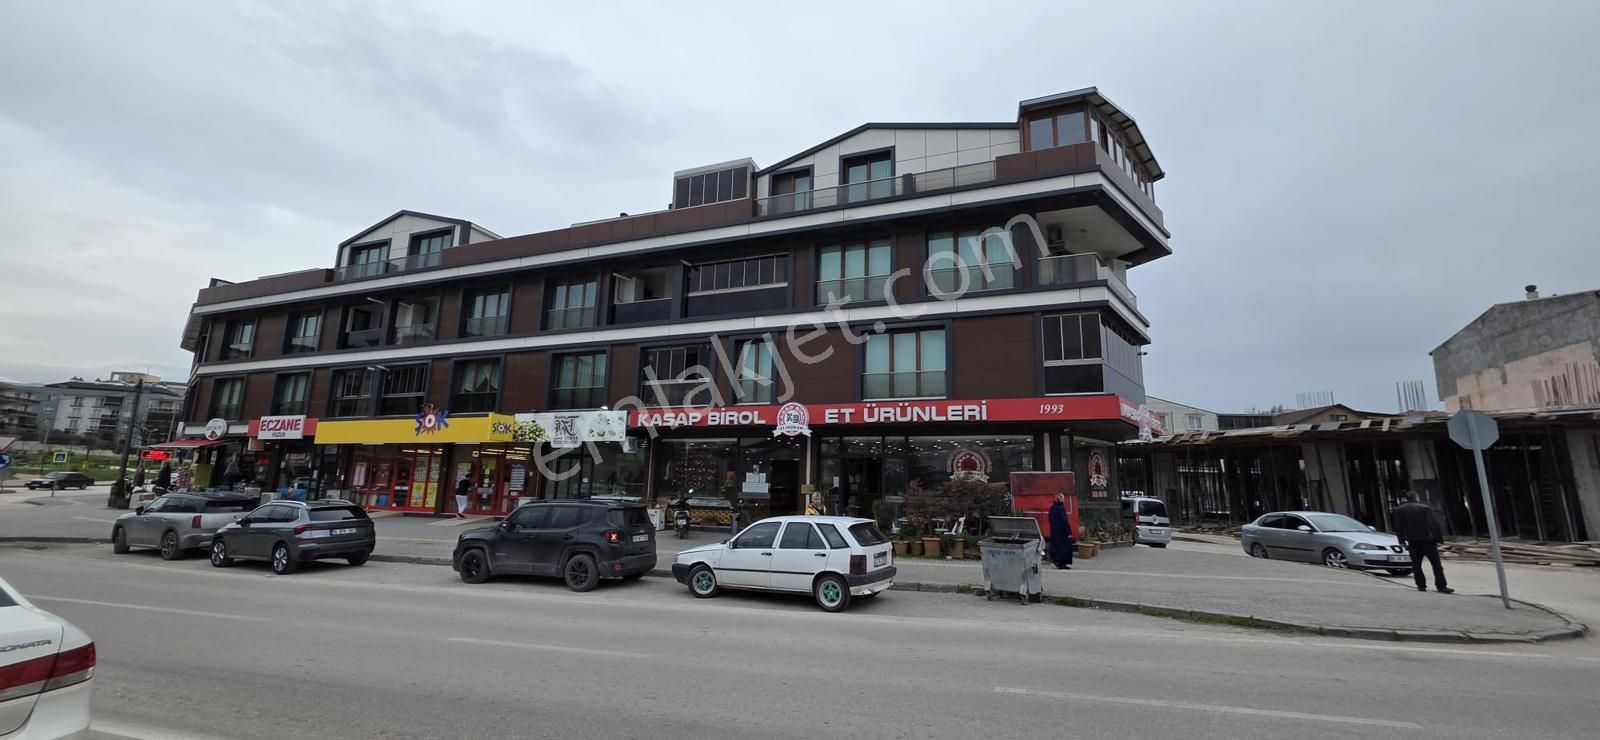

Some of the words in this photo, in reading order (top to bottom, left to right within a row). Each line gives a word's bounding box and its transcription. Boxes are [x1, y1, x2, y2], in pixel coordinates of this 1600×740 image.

[637, 412, 701, 427] KASAP
[707, 408, 767, 425] BİROL
[824, 408, 855, 424] ET
[863, 400, 988, 423] ÜRÜNLERİ
[1040, 404, 1065, 415] 1993
[260, 419, 302, 432] ECZANE
